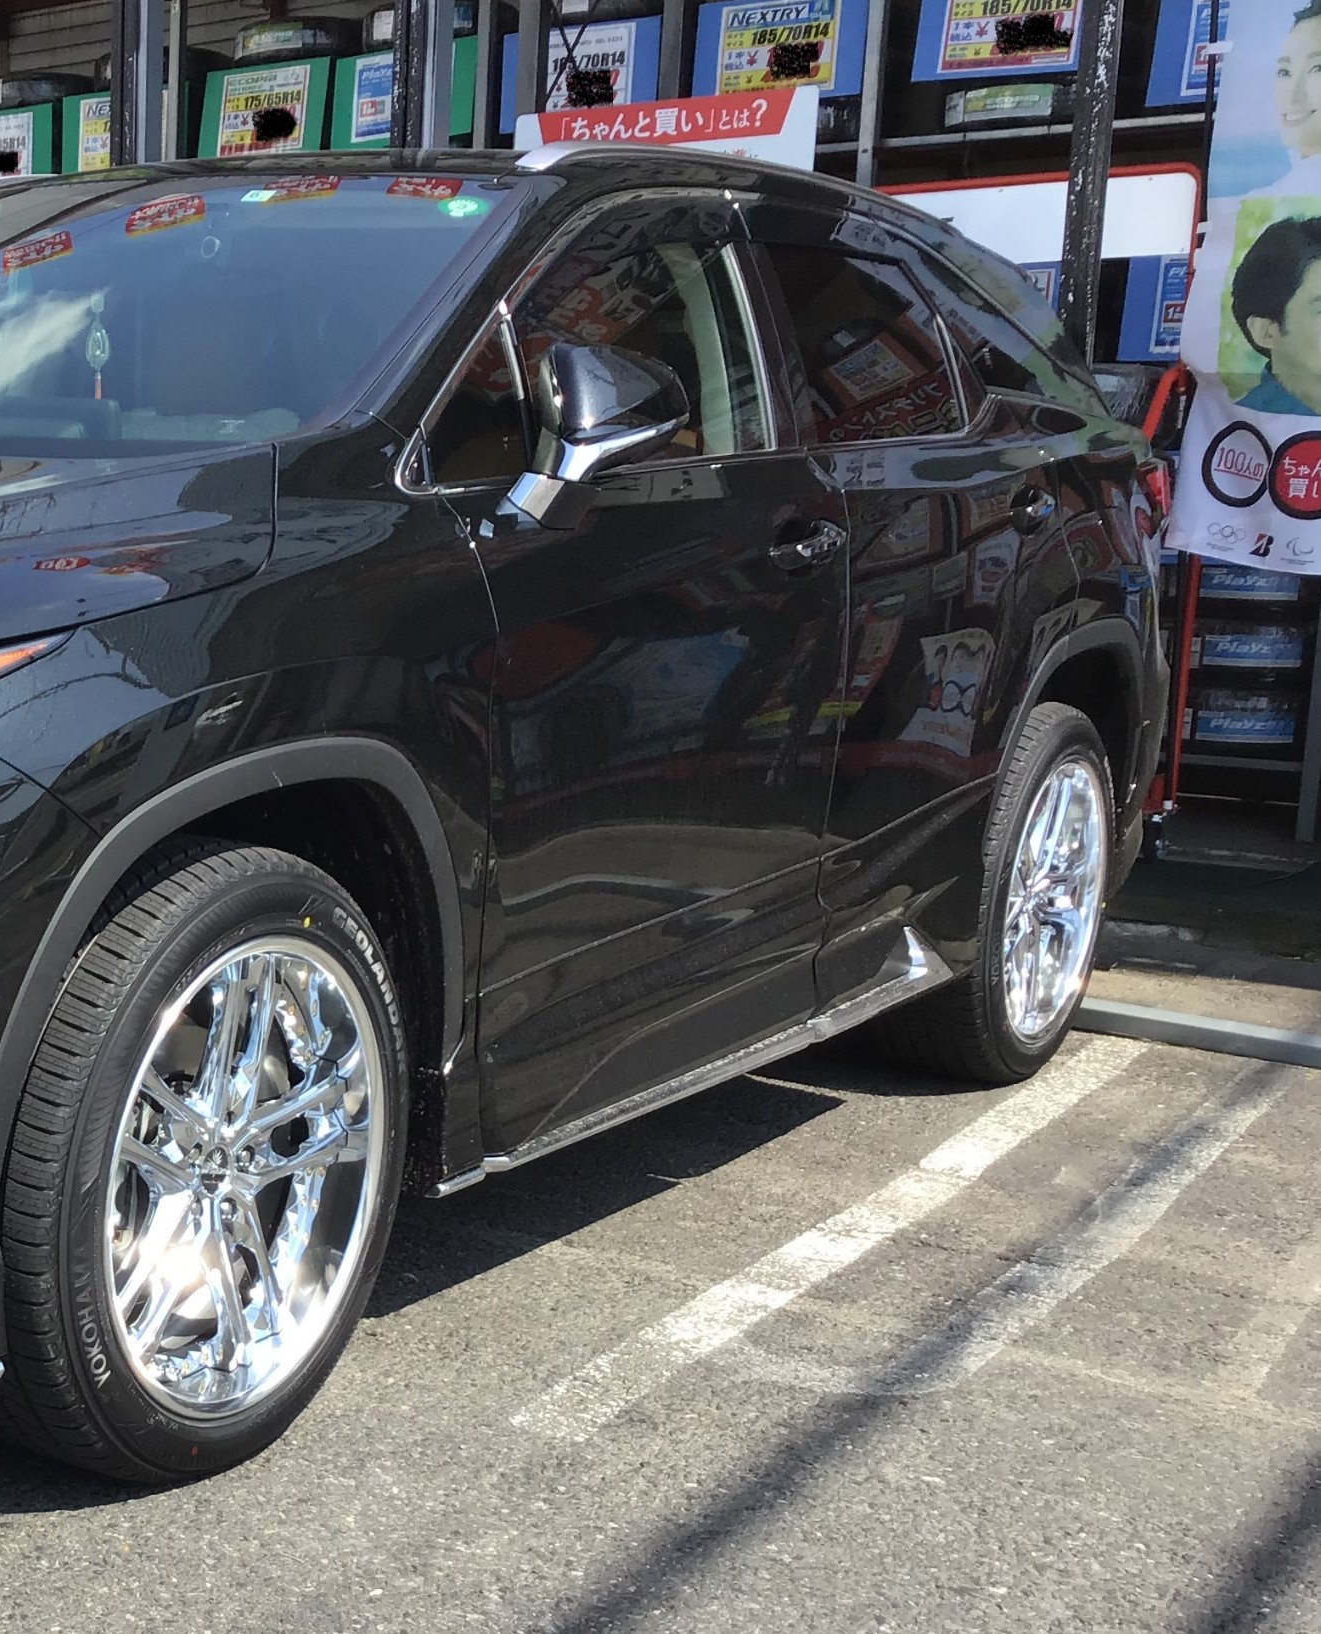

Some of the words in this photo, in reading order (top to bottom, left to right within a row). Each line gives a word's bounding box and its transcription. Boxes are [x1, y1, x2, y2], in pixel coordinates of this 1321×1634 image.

[729, 5, 807, 27] NEXTRY
[751, 22, 831, 46] 185/70R14
[244, 89, 302, 110] 175/65R14
